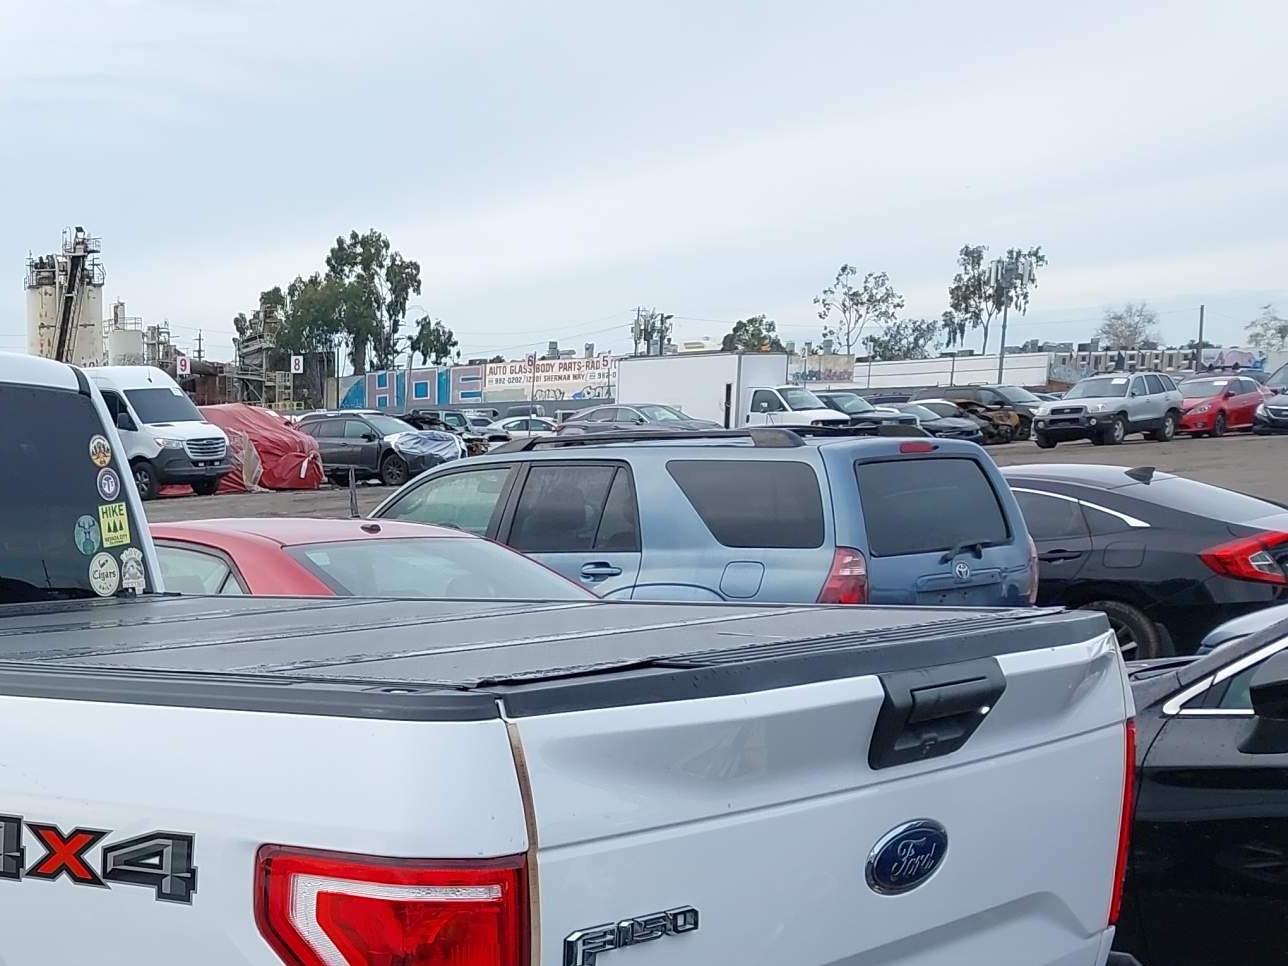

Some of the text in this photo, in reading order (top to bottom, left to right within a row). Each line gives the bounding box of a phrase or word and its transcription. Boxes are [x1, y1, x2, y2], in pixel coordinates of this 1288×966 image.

[179, 358, 188, 372] 9
[293, 358, 301, 371] 8
[527, 355, 534, 367] 6
[602, 355, 609, 367] 5
[489, 365, 507, 376] AUTO
[509, 364, 533, 375] GLASS
[535, 362, 556, 374] BODY
[101, 504, 125, 520] HIKE
[92, 569, 117, 581] Cigars
[890, 836, 937, 882] Ford
